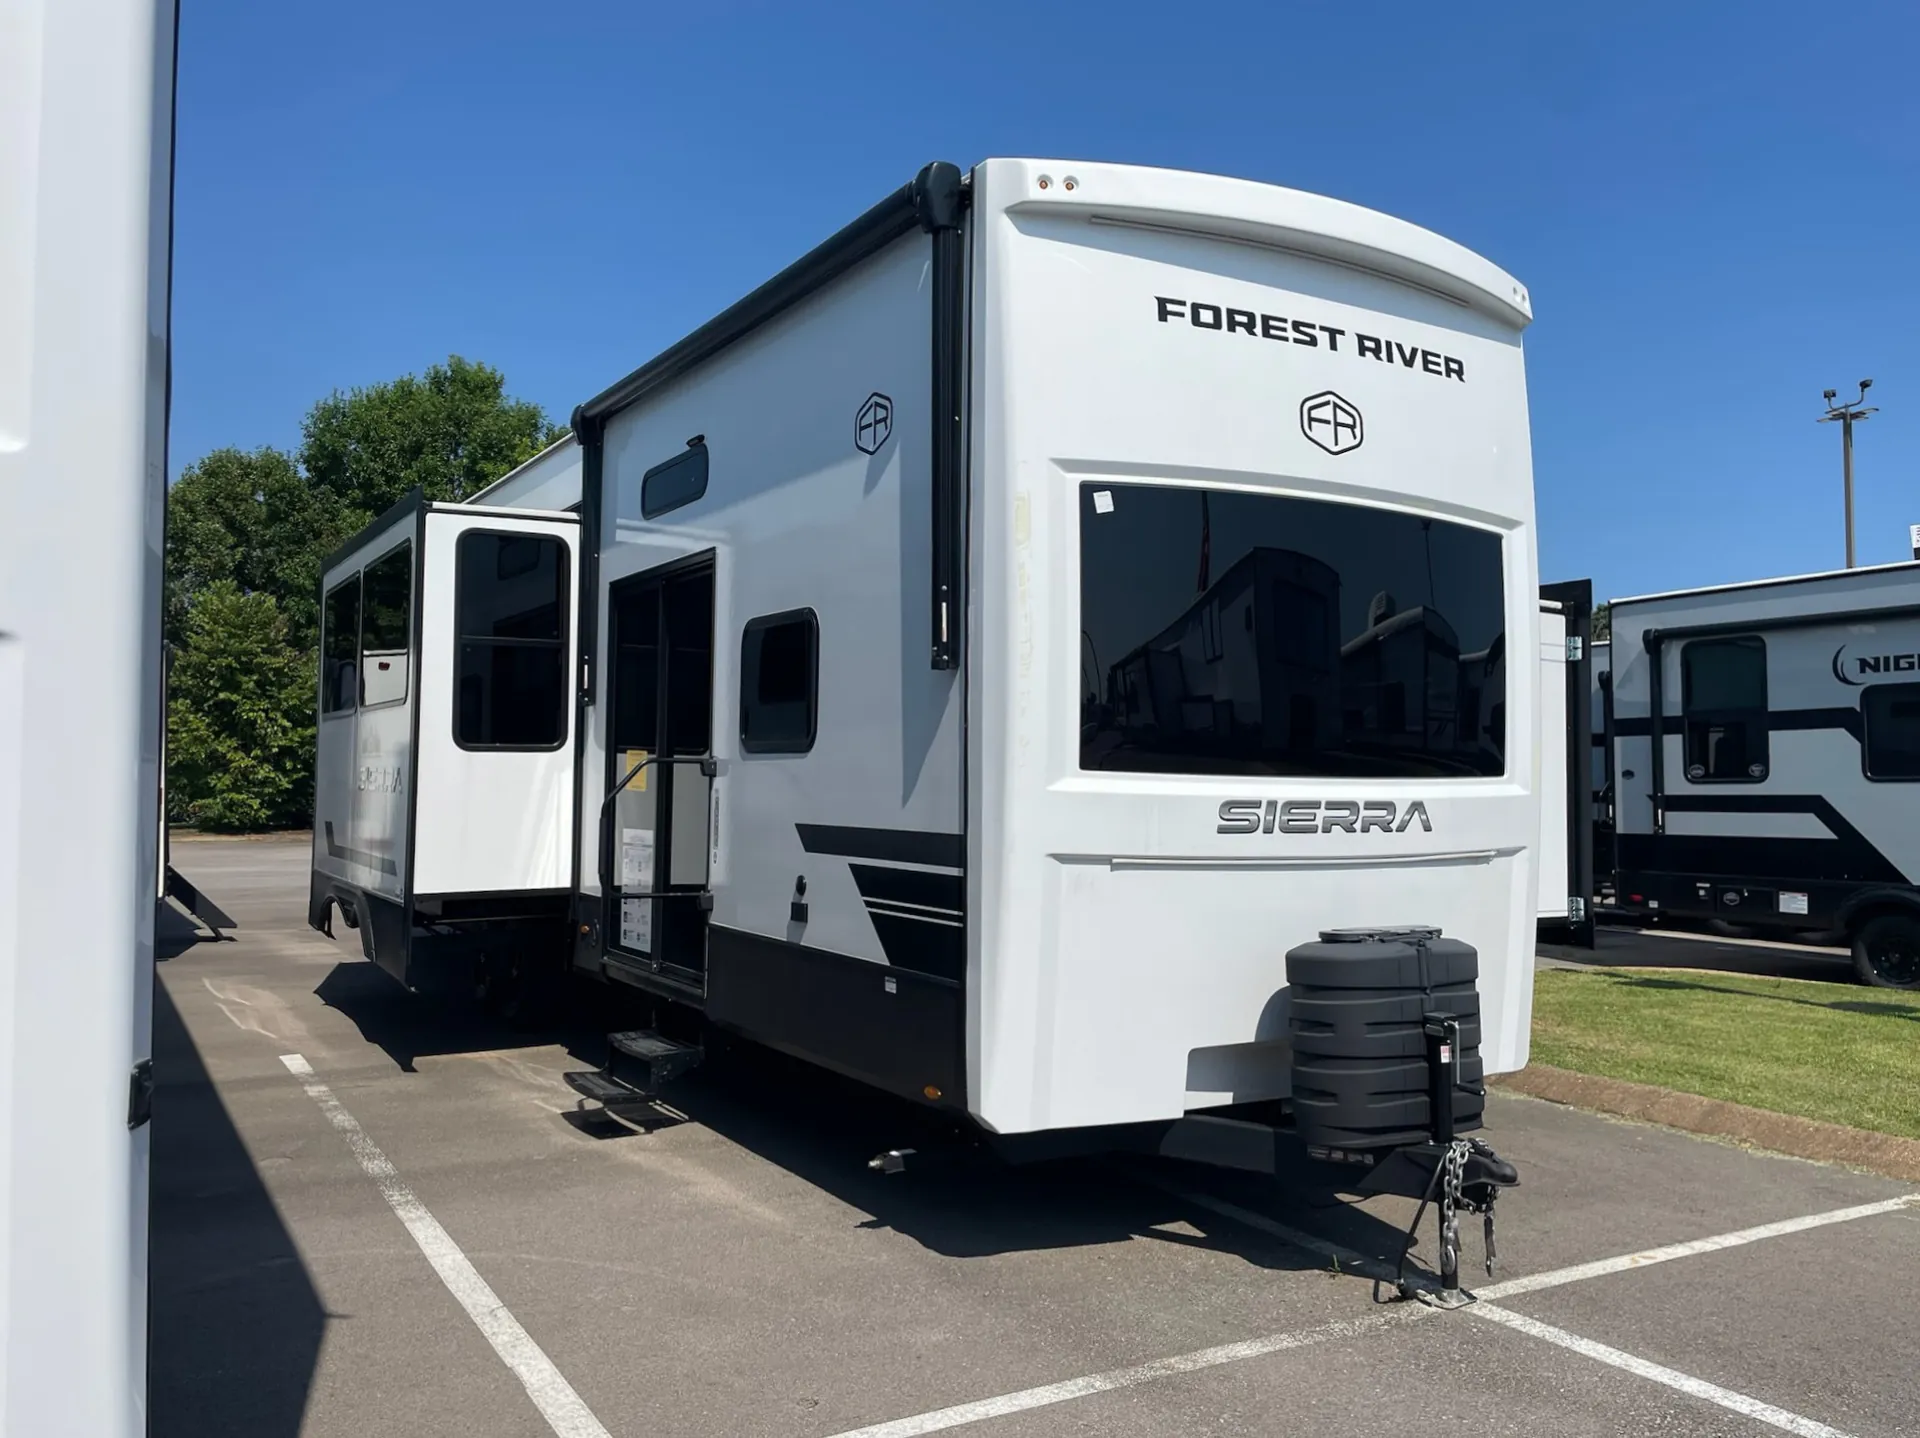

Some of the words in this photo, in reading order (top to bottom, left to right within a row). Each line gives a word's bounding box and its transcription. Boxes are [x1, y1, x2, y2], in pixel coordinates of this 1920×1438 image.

[1154, 296, 1345, 352] FOREST
[1354, 332, 1466, 383] RIVER
[1305, 397, 1358, 449] FR
[1855, 653, 1920, 674] NIG
[1216, 799, 1433, 834] SIERRA
